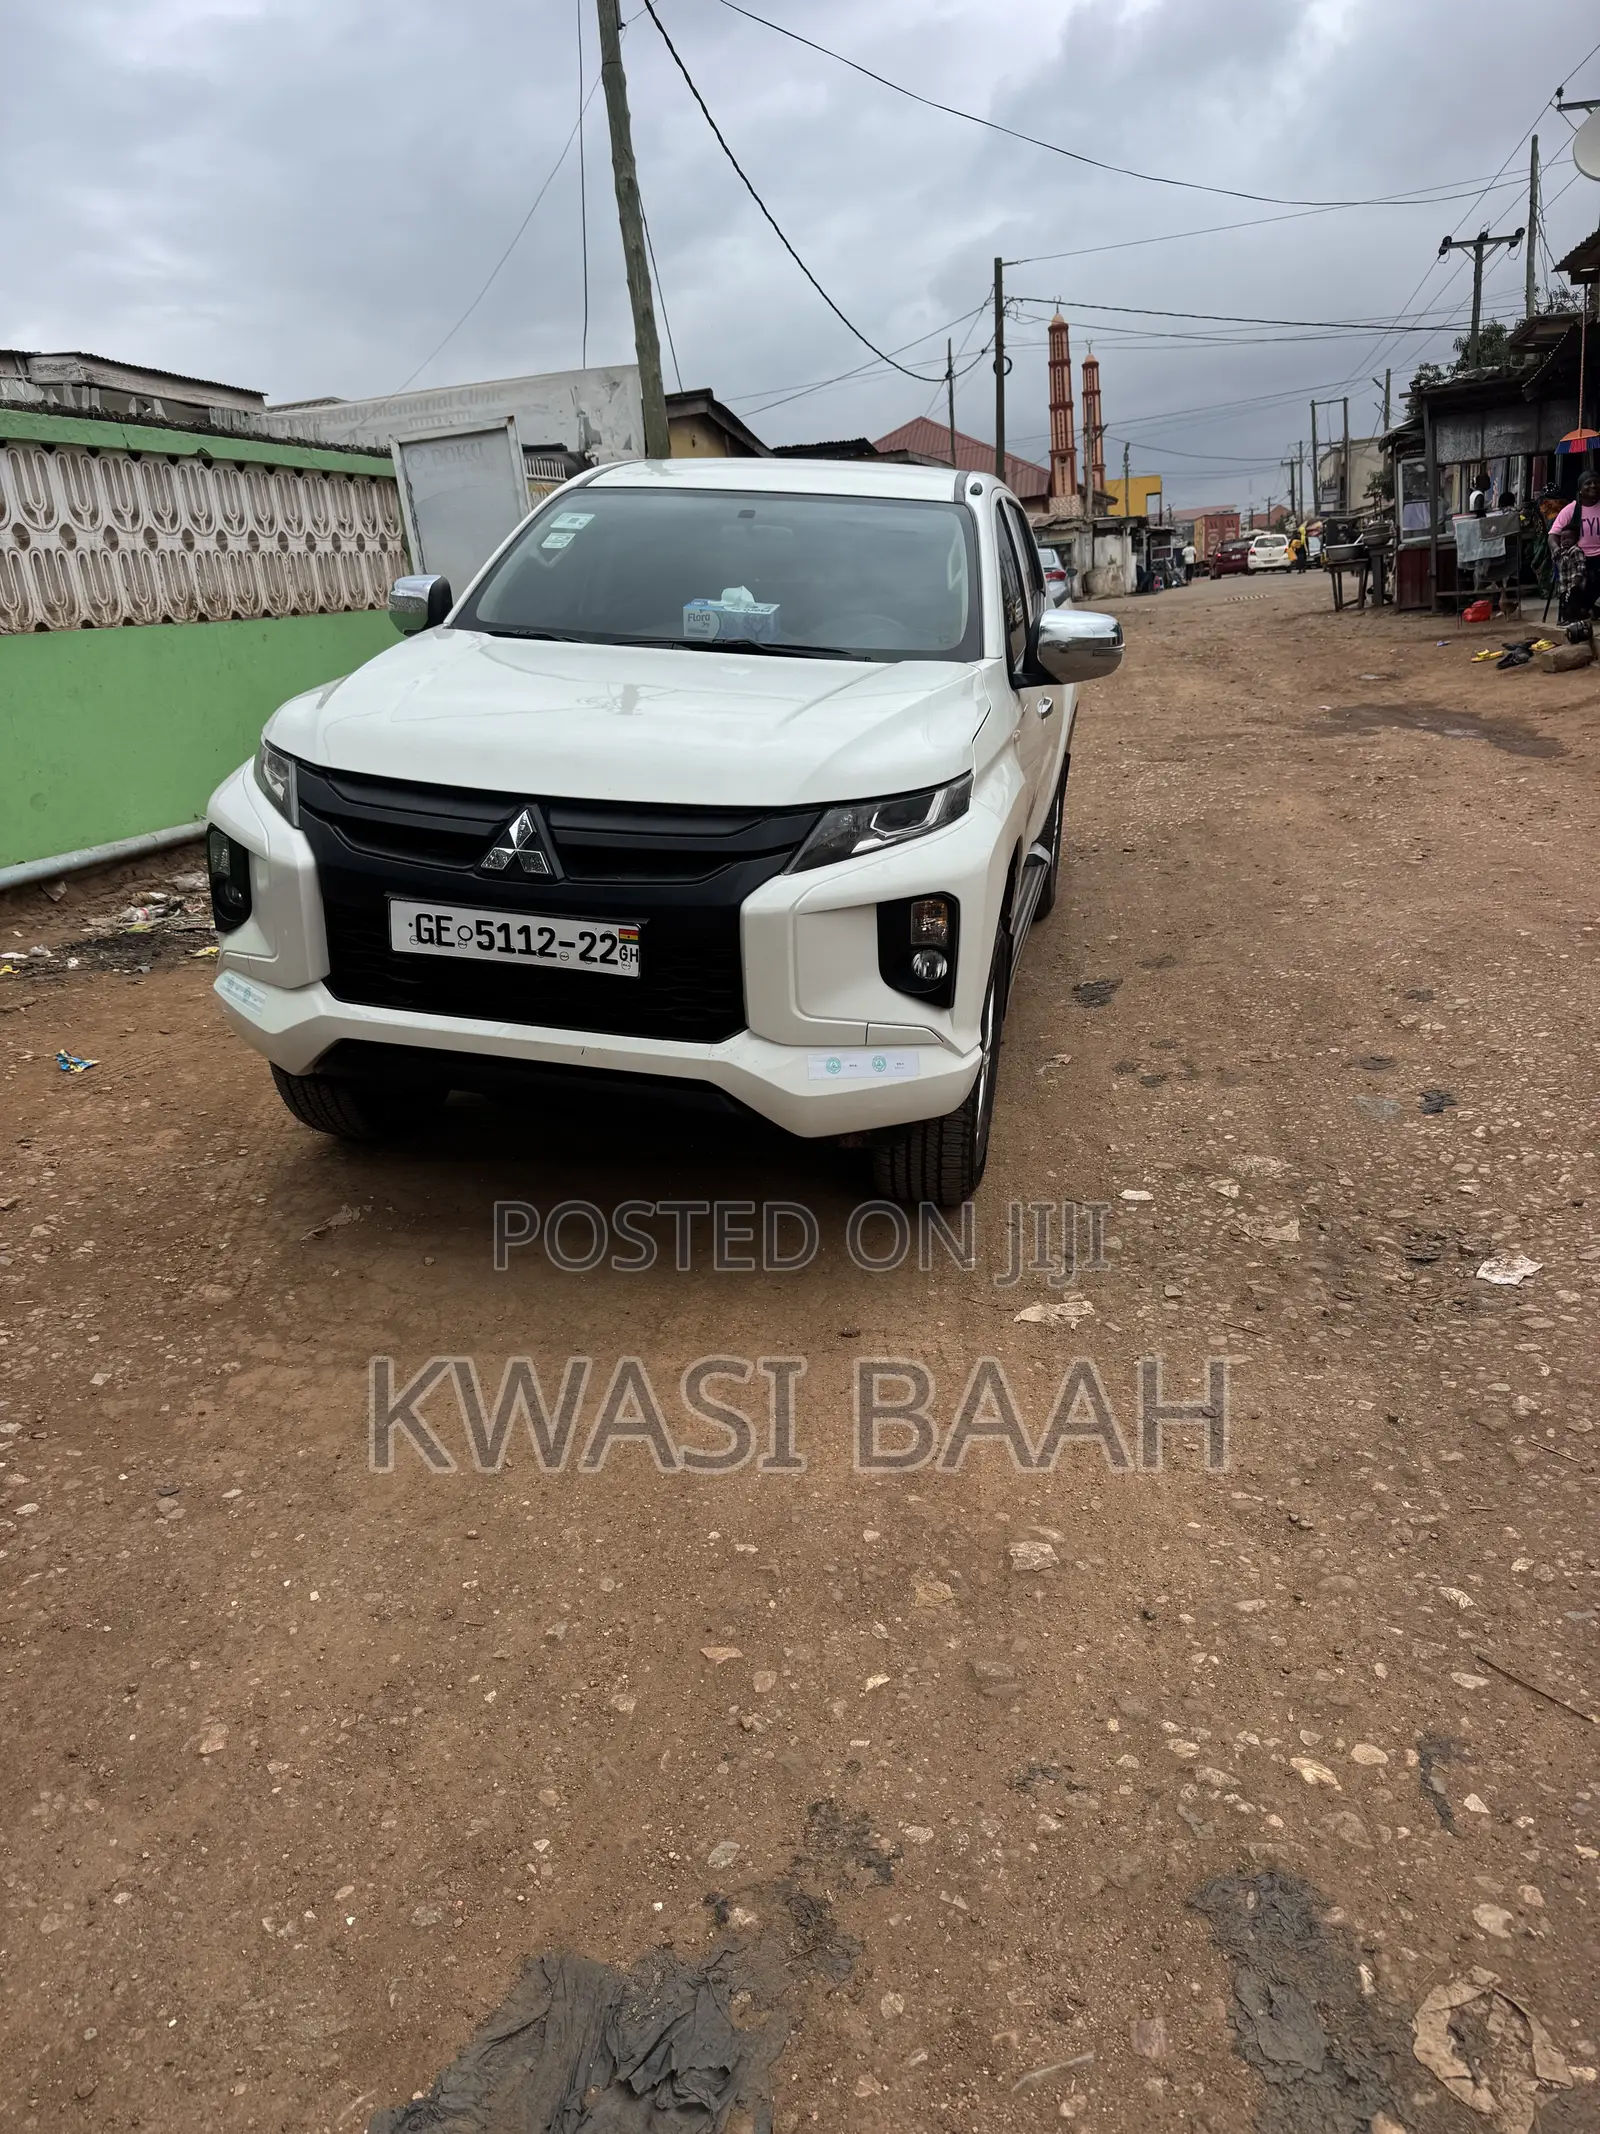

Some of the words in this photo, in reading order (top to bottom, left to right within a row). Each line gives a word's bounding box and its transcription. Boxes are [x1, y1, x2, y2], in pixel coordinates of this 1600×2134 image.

[458, 386, 505, 406] Clinic
[687, 612, 711, 622] Flora
[415, 913, 456, 947] GE
[474, 919, 618, 965] 5112-22
[619, 944, 639, 963] GH
